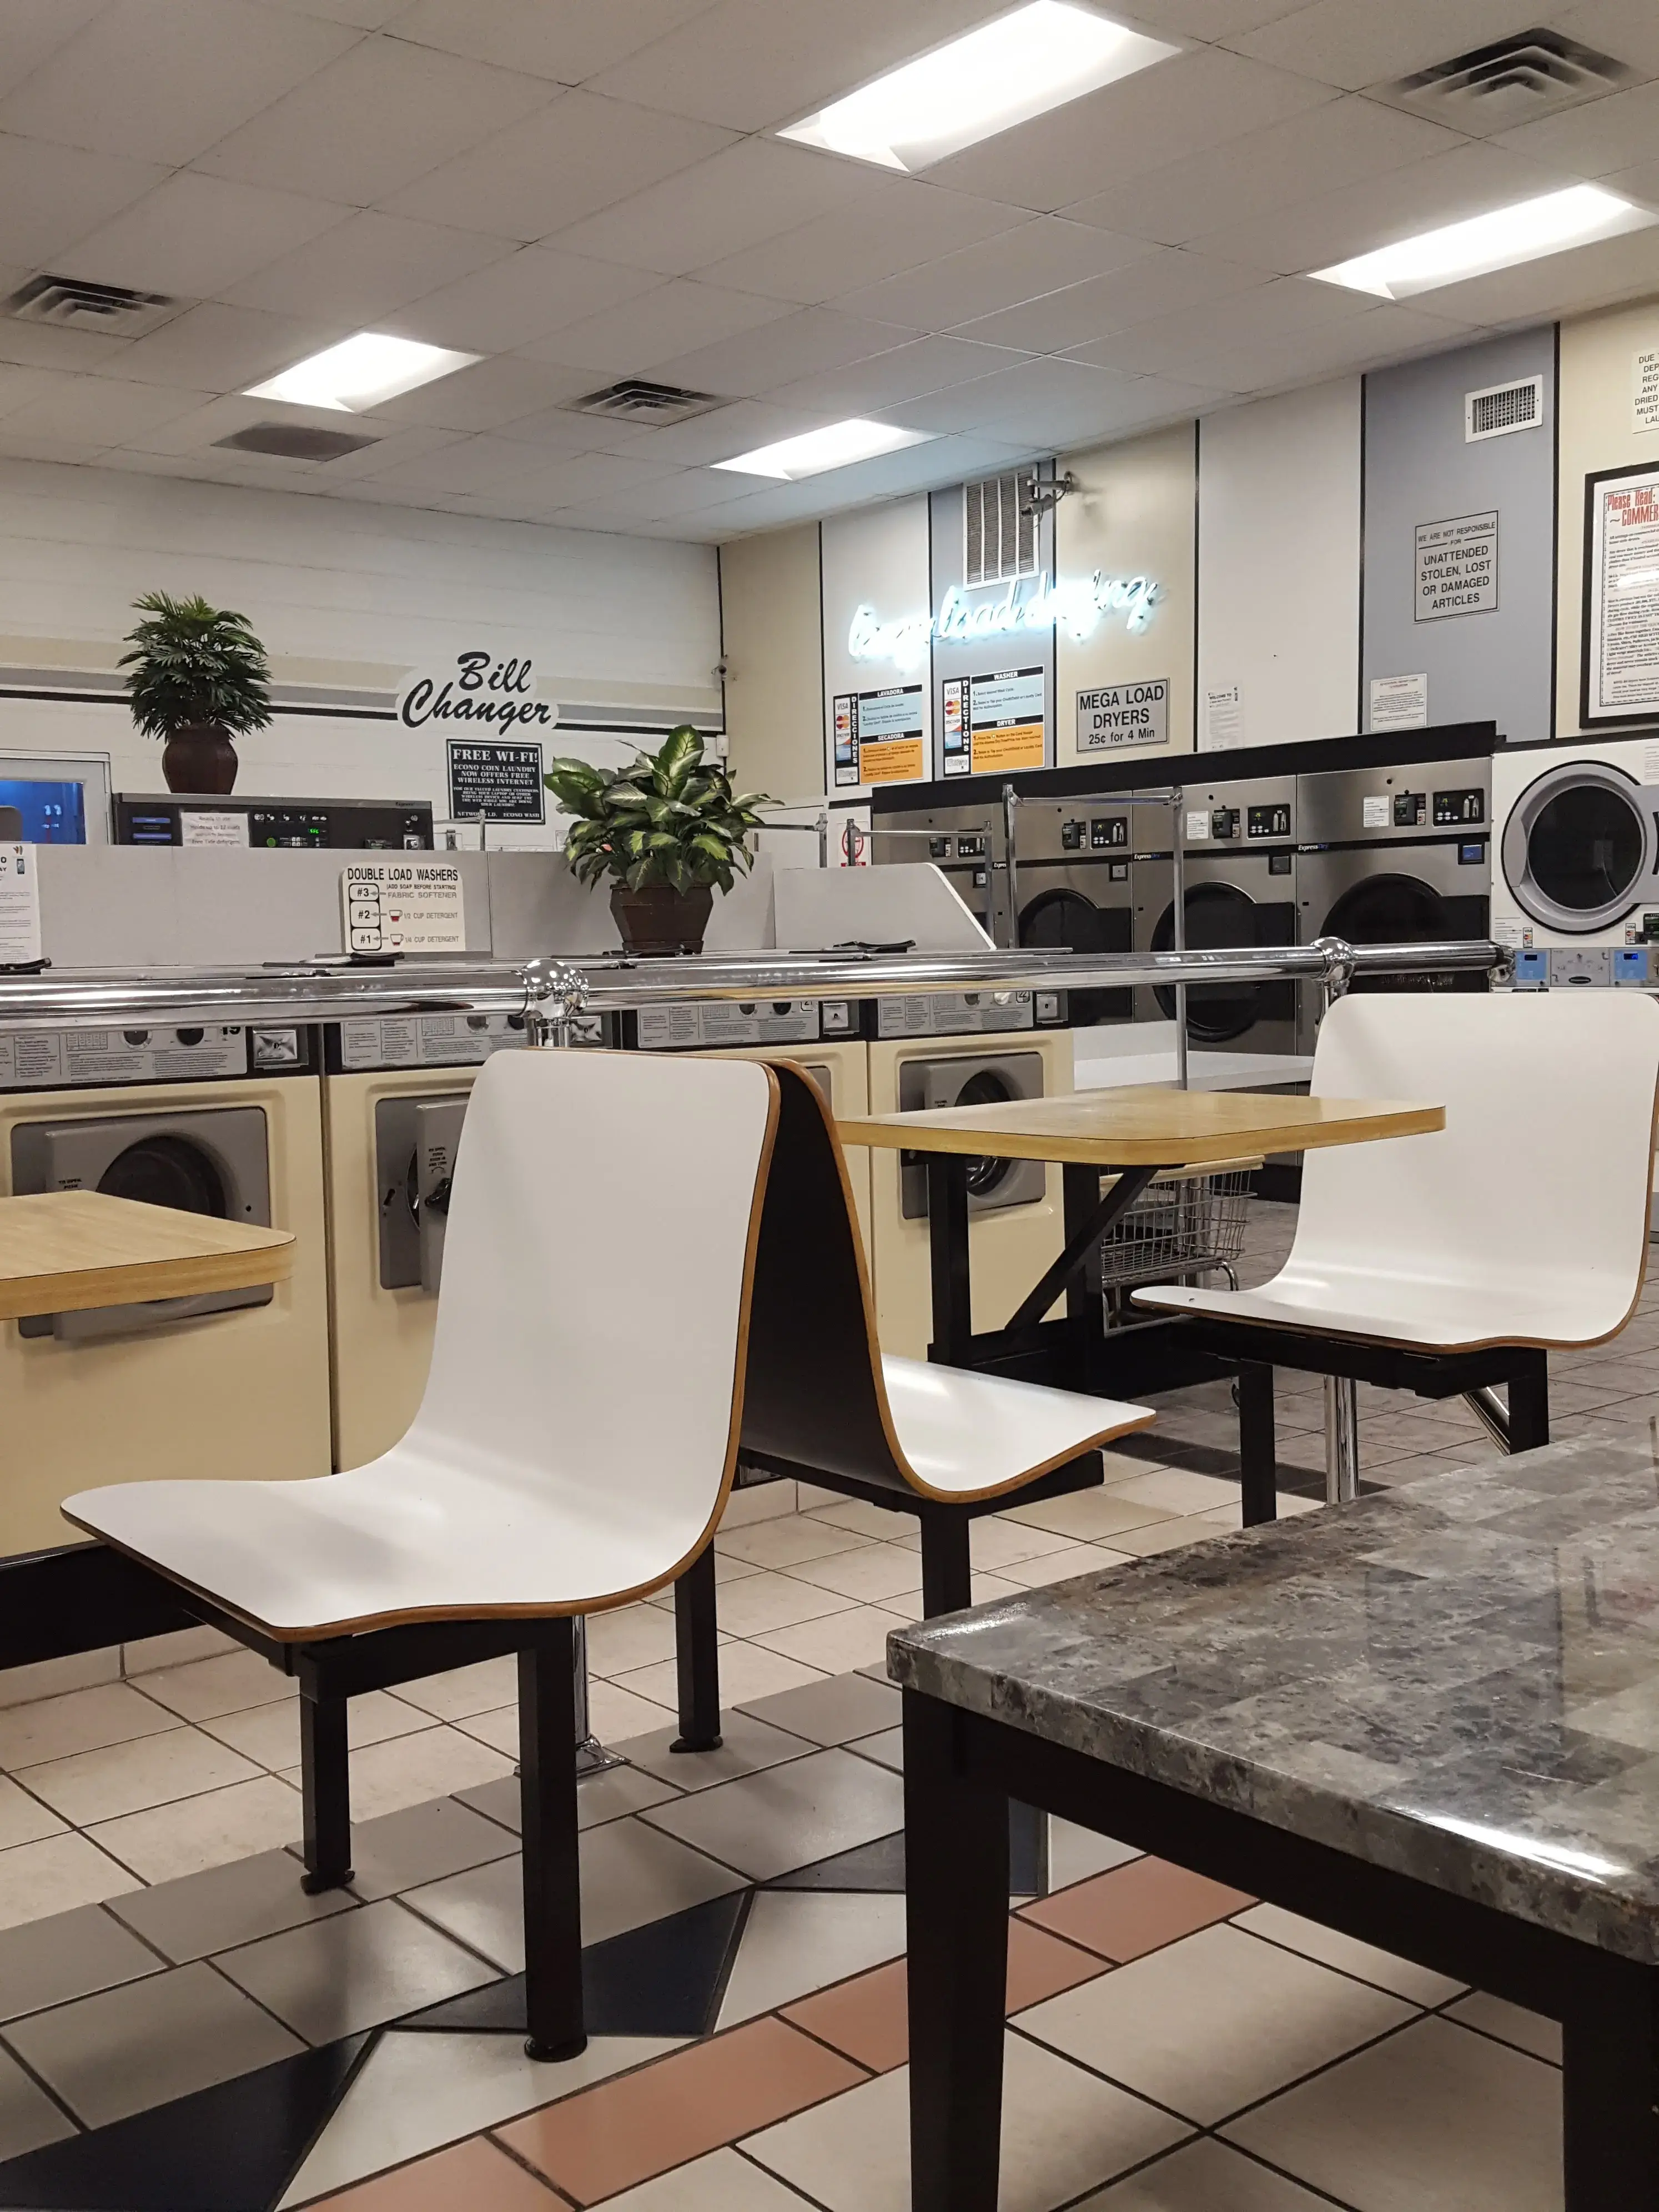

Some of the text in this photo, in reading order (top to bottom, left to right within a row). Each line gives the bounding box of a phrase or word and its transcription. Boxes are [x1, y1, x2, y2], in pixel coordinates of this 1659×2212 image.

[1639, 354, 1655, 364] DUE
[1642, 384, 1658, 394] ANY
[1635, 394, 1658, 405] DRIED
[1636, 404, 1659, 415] MUST
[1607, 494, 1631, 511] Please
[1443, 529, 1454, 538] NOT
[1456, 521, 1495, 535] RESPONSIBLE
[1424, 545, 1489, 566] UNATTENDED
[1421, 560, 1491, 581] STOLEN, LOST
[1422, 576, 1490, 596] OR DAMAGED
[1432, 593, 1480, 610] ARTICLES
[458, 651, 532, 693] Bill
[994, 671, 1018, 681] WASHER
[877, 688, 903, 697] LAVADORA
[947, 687, 959, 695] VISA
[1080, 685, 1164, 710] MEGA LOAD
[402, 678, 551, 735] Changer
[1093, 708, 1149, 729] DRYERS
[878, 733, 904, 741] SECADORA
[1110, 732, 1124, 742] for
[1128, 730, 1134, 740] 4
[1139, 727, 1155, 738] Min
[453, 749, 538, 763] FREE WI-FI!
[348, 868, 458, 881] DOUBLE LOAD WASHERS
[357, 888, 369, 897] #3
[358, 910, 370, 919] #2
[360, 934, 371, 944] #1
